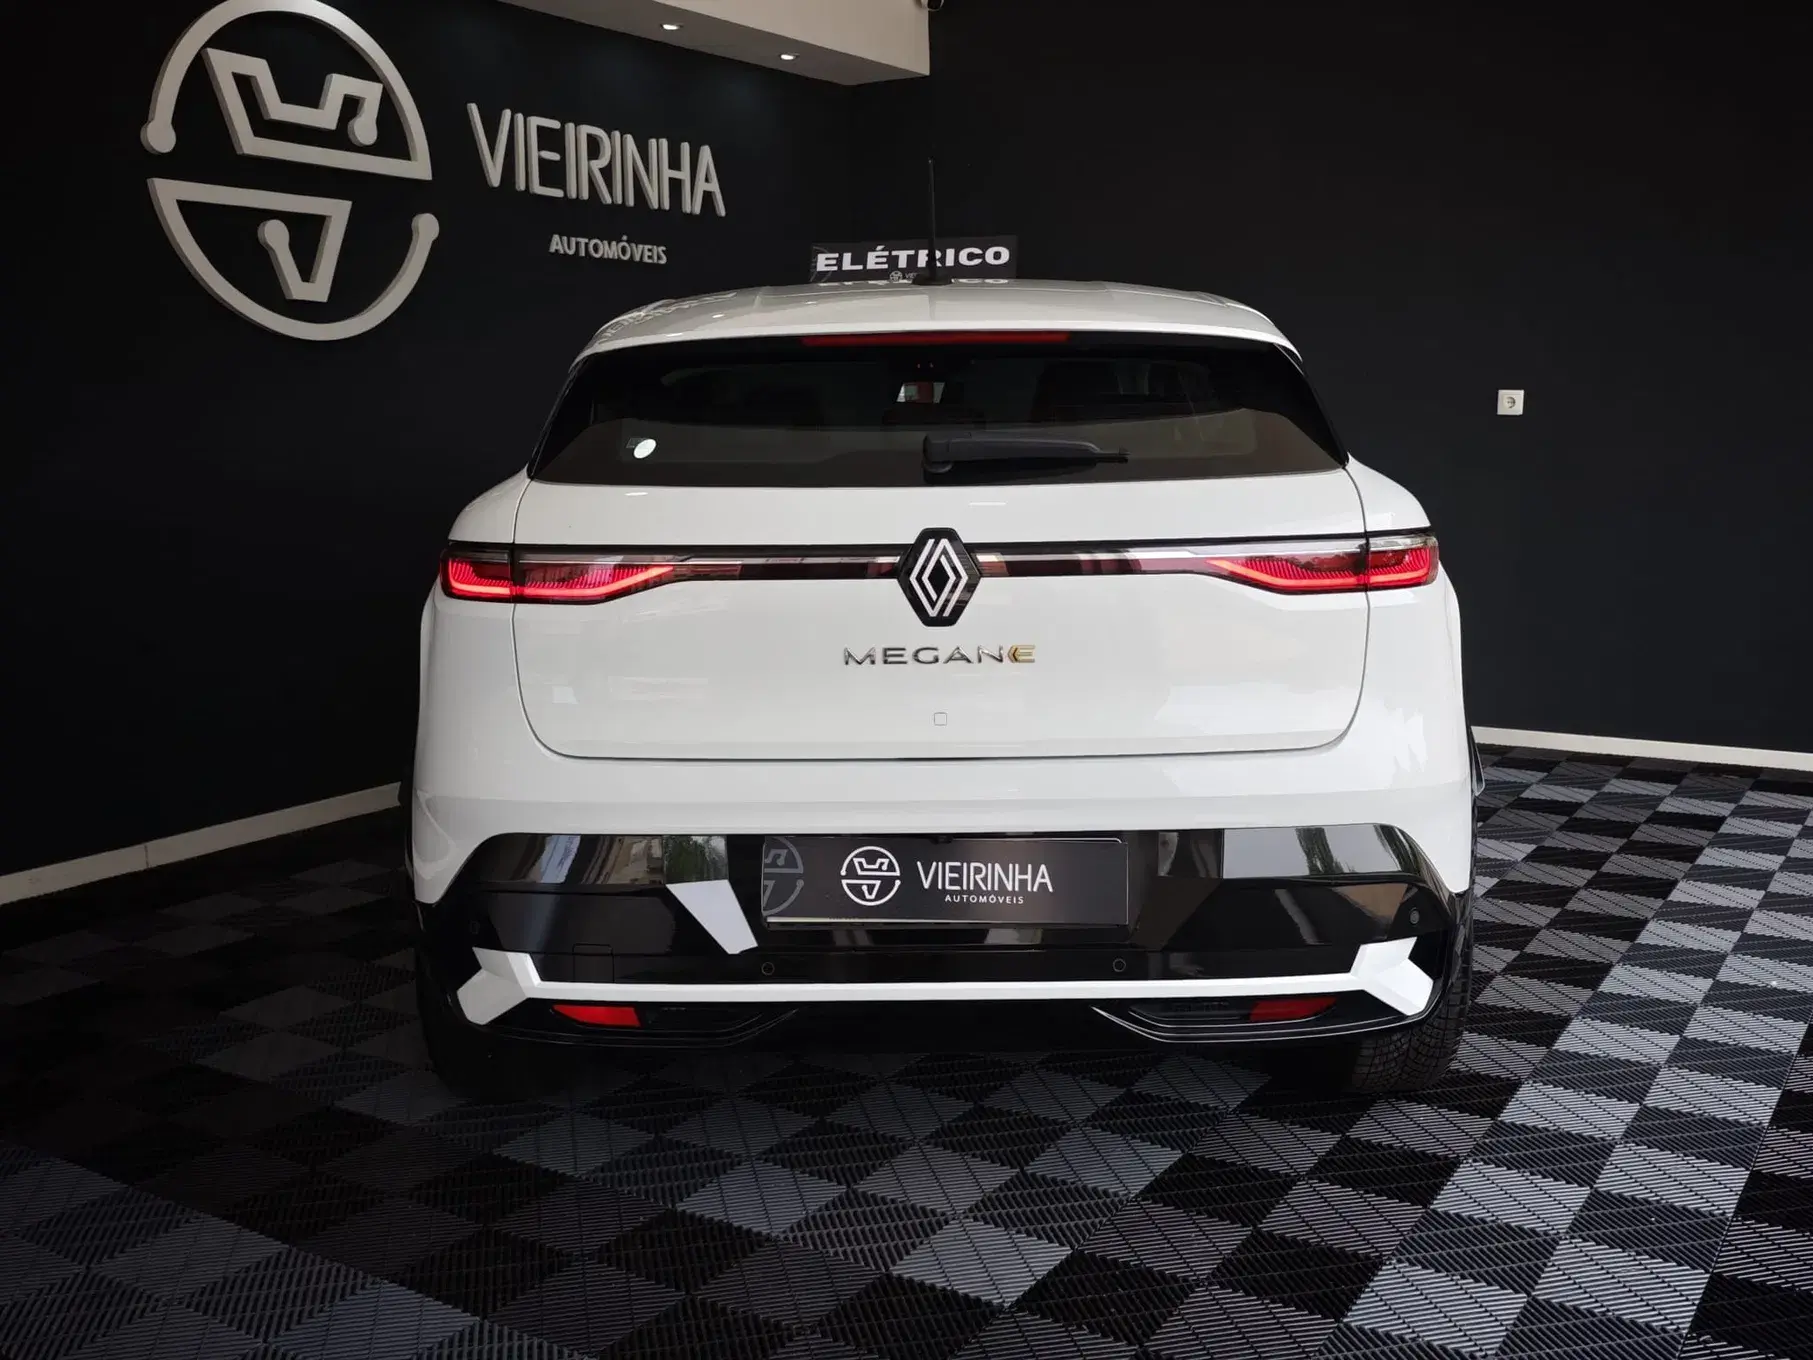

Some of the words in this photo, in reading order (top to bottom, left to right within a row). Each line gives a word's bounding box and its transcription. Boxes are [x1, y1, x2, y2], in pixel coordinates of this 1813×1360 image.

[467, 103, 726, 217] VIEIRINHA
[549, 234, 668, 264] AUTOMÓVEIS
[816, 245, 1010, 272] ELÉTRICO
[844, 645, 1035, 665] MEGANE
[917, 861, 1053, 892] VIEIRINHA
[944, 893, 1024, 905] AUTOMÓVEIS
